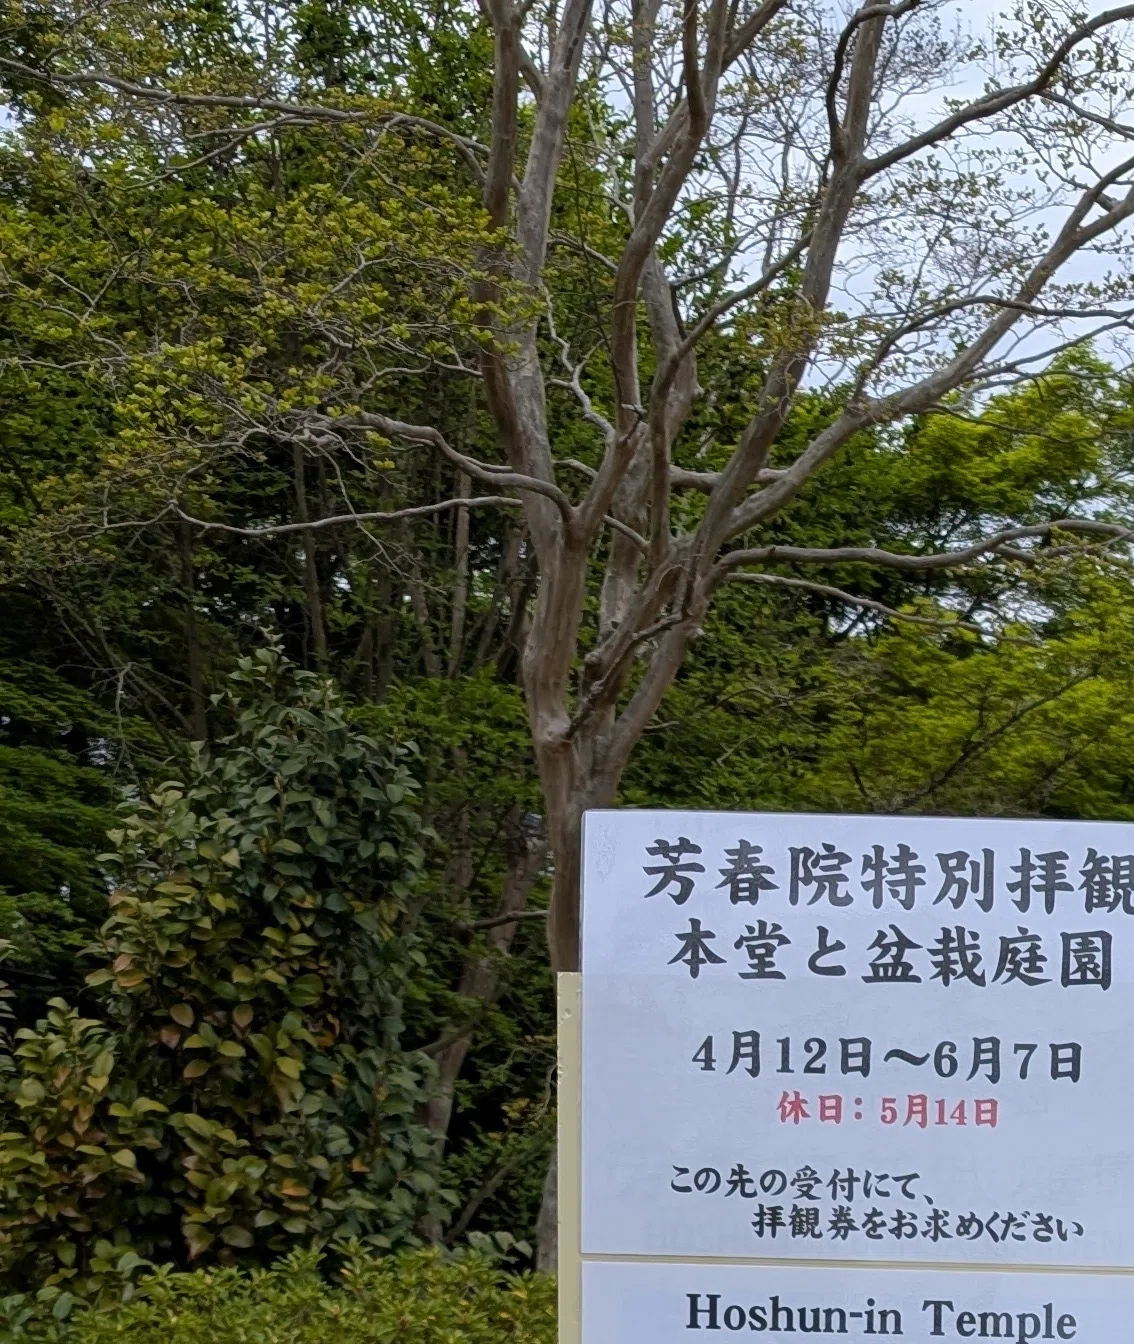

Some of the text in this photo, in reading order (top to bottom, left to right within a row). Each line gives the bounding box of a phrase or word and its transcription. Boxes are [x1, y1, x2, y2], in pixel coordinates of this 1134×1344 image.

[667, 918, 1112, 991] 本堂と盆栽庭園
[671, 1164, 935, 1207] この先の受付にて、
[751, 1205, 1084, 1243] 拝観券をお求めください
[686, 1294, 1076, 1344] Hoshun-in Temple
